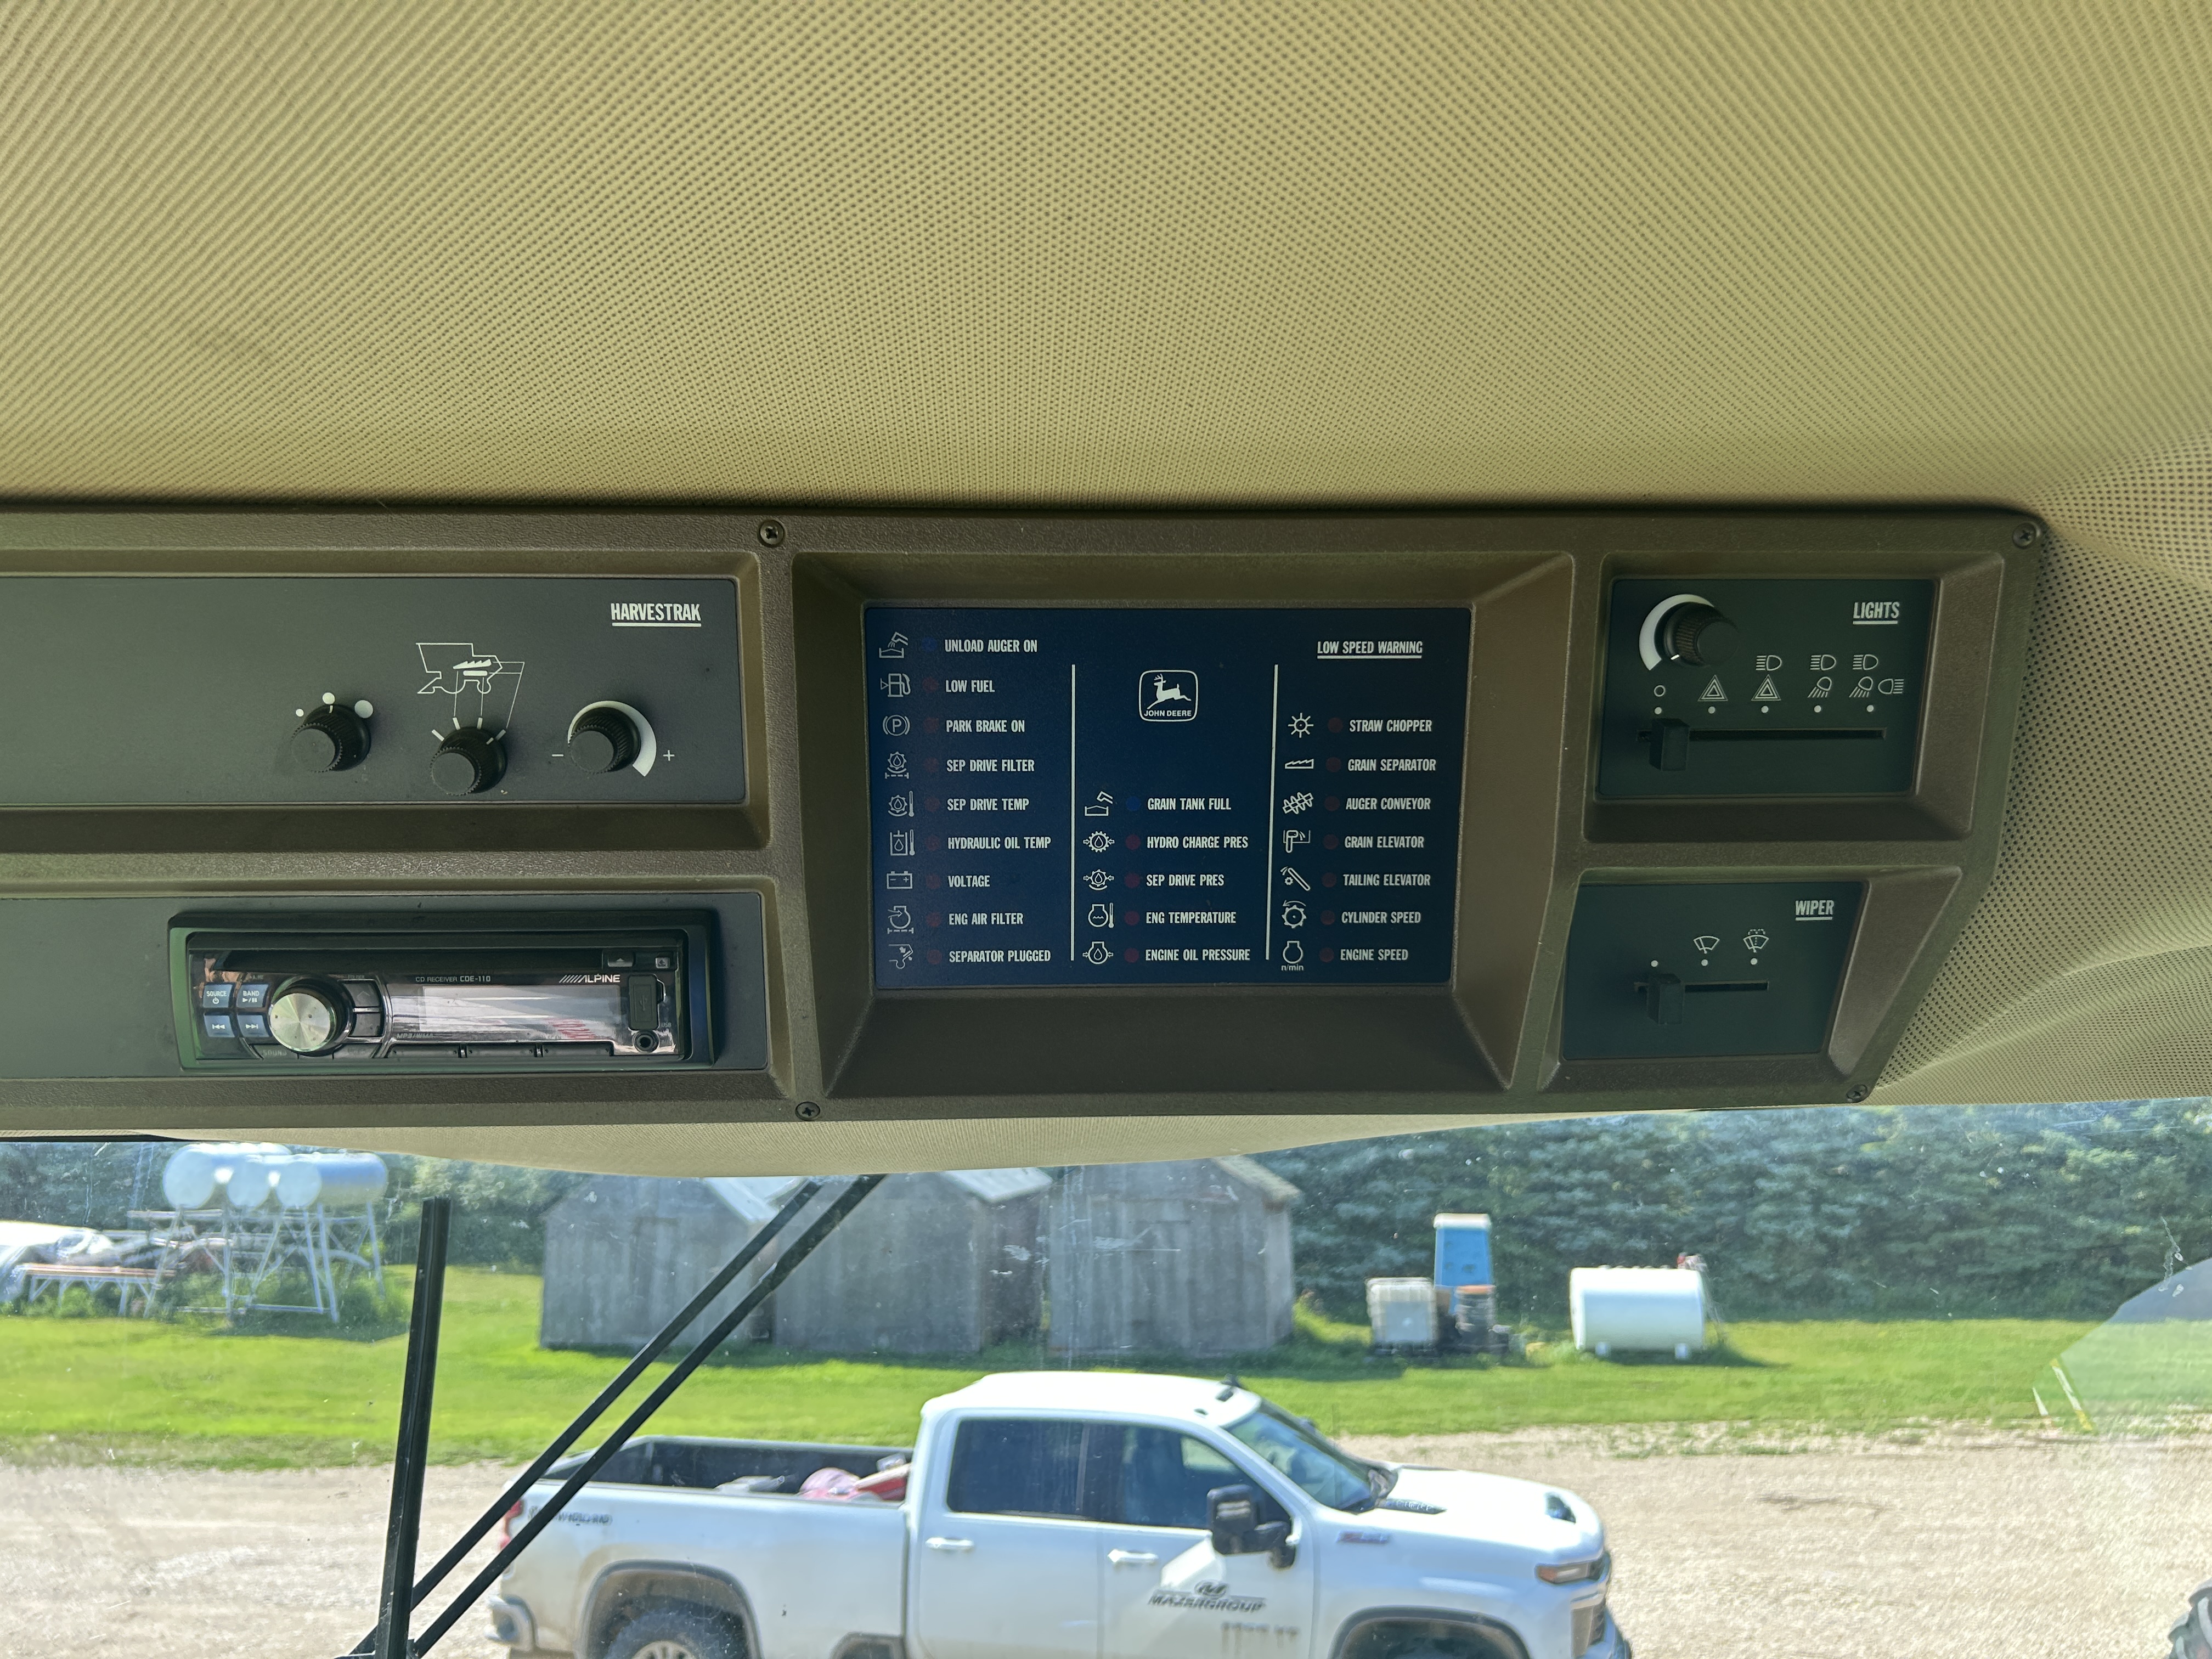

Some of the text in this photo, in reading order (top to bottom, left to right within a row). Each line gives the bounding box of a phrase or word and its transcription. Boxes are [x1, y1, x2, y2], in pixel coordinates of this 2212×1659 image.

[611, 603, 701, 621] HARVESTRAK
[1853, 601, 1900, 619] LIGHTS
[945, 639, 1037, 652] UNLOAD AUGER ON
[1317, 641, 1423, 654] LOW SPEED WARNING
[945, 680, 995, 693] LOW FUEL
[946, 720, 1025, 732] PARK BRAKE ON
[1349, 719, 1432, 732] STRAW CHOPPER
[946, 759, 1035, 772] SEP DRIVE FILTER
[1347, 758, 1437, 771] GRAIN SEPARATOR
[947, 798, 1029, 811] SEP DRIVE TEMP
[1147, 798, 1232, 810] GRAIN TANK FULL
[1345, 797, 1431, 810] AUGER CONVEYOR
[948, 836, 1051, 849] HYDRAULIC OIL TEMP
[1147, 836, 1249, 849] HYDRO CHARGE PRES
[1344, 836, 1425, 848] GRAIN ELEVATOR
[947, 875, 990, 888] VOLTAGE
[1146, 874, 1224, 887] SEP DRIVE PRES
[1342, 873, 1431, 886] TAILING ELEVATOR
[1795, 900, 1835, 916] WIPER
[949, 912, 1024, 926] ENG AIR FILTER
[1146, 911, 1237, 924] ENG TEMPERATURE
[1341, 911, 1421, 923] CYLINDER SPEED
[949, 950, 1051, 963] SEPARATOR PLUGGED
[1145, 949, 1250, 961] ENGINE OIL PRESSURE
[1340, 949, 1408, 961] ENGINE SPEED
[1281, 963, 1304, 971] n/min
[576, 974, 620, 983] ALPINE
